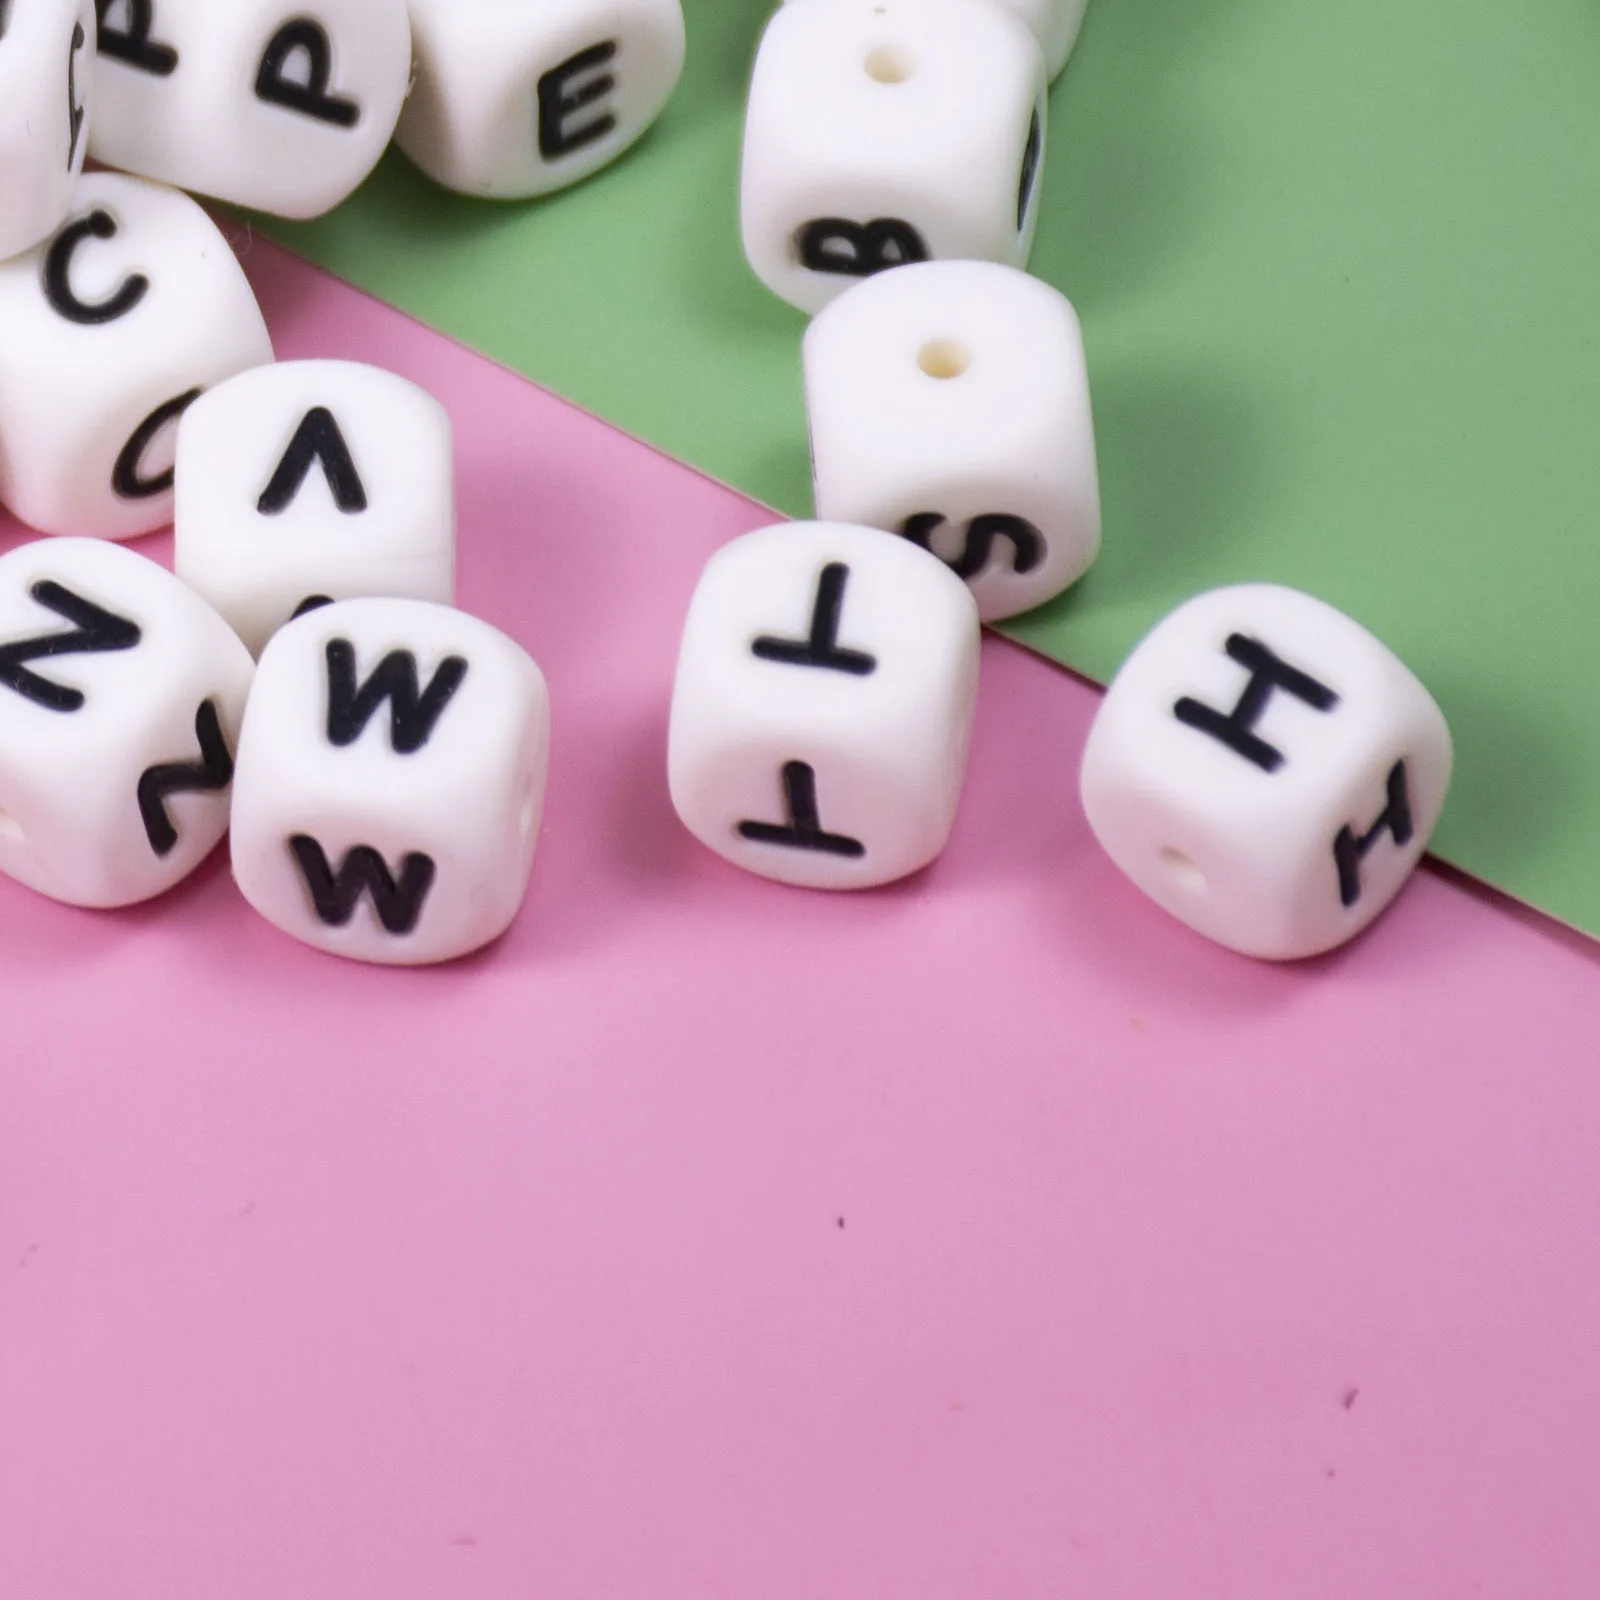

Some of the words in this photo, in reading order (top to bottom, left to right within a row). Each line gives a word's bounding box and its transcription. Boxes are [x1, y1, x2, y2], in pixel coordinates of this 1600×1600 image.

[254, 16, 361, 130] P
[536, 40, 618, 163] E
[40, 208, 149, 325] C
[752, 562, 875, 675] T
[325, 638, 468, 755] W
[1172, 631, 1337, 771] H
[737, 759, 865, 858] T
[1332, 756, 1416, 908] H
[287, 833, 436, 937] W
